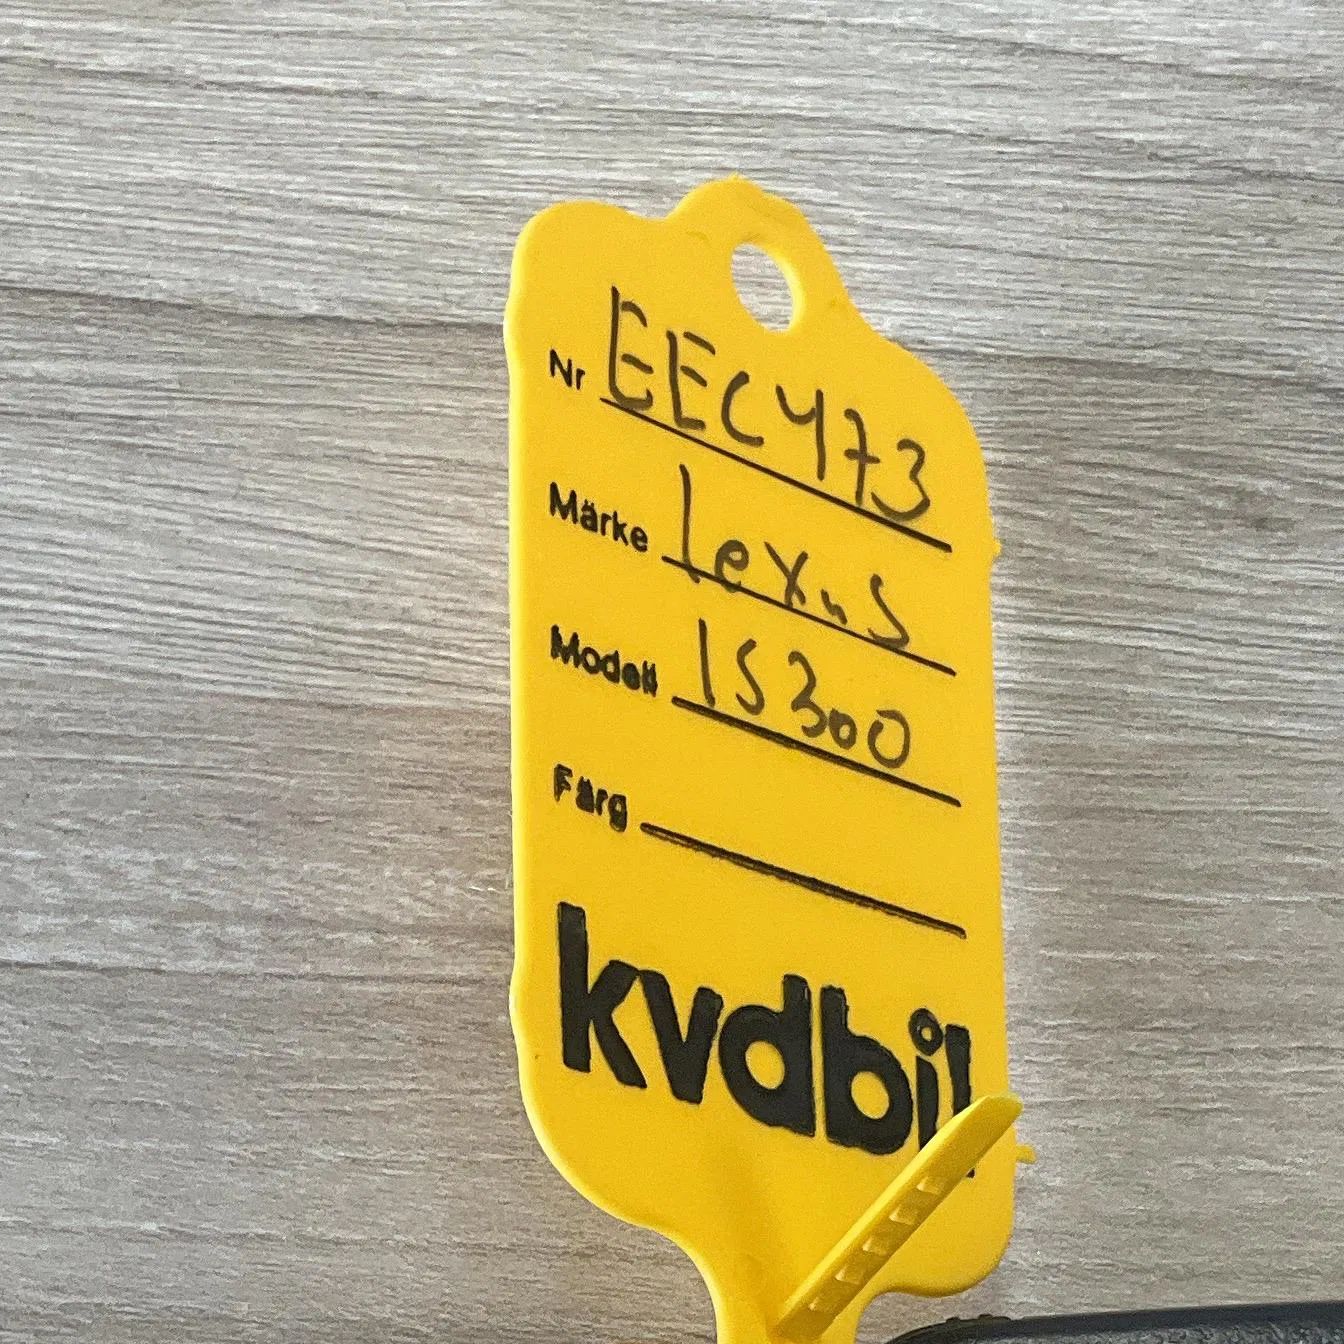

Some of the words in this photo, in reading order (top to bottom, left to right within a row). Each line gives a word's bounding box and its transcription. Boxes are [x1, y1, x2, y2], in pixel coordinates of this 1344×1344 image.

[549, 348, 585, 390] Nr
[549, 481, 649, 553] Märke
[550, 624, 658, 698] Modell
[552, 763, 628, 832] Färg
[556, 900, 975, 1178] kvdbil
